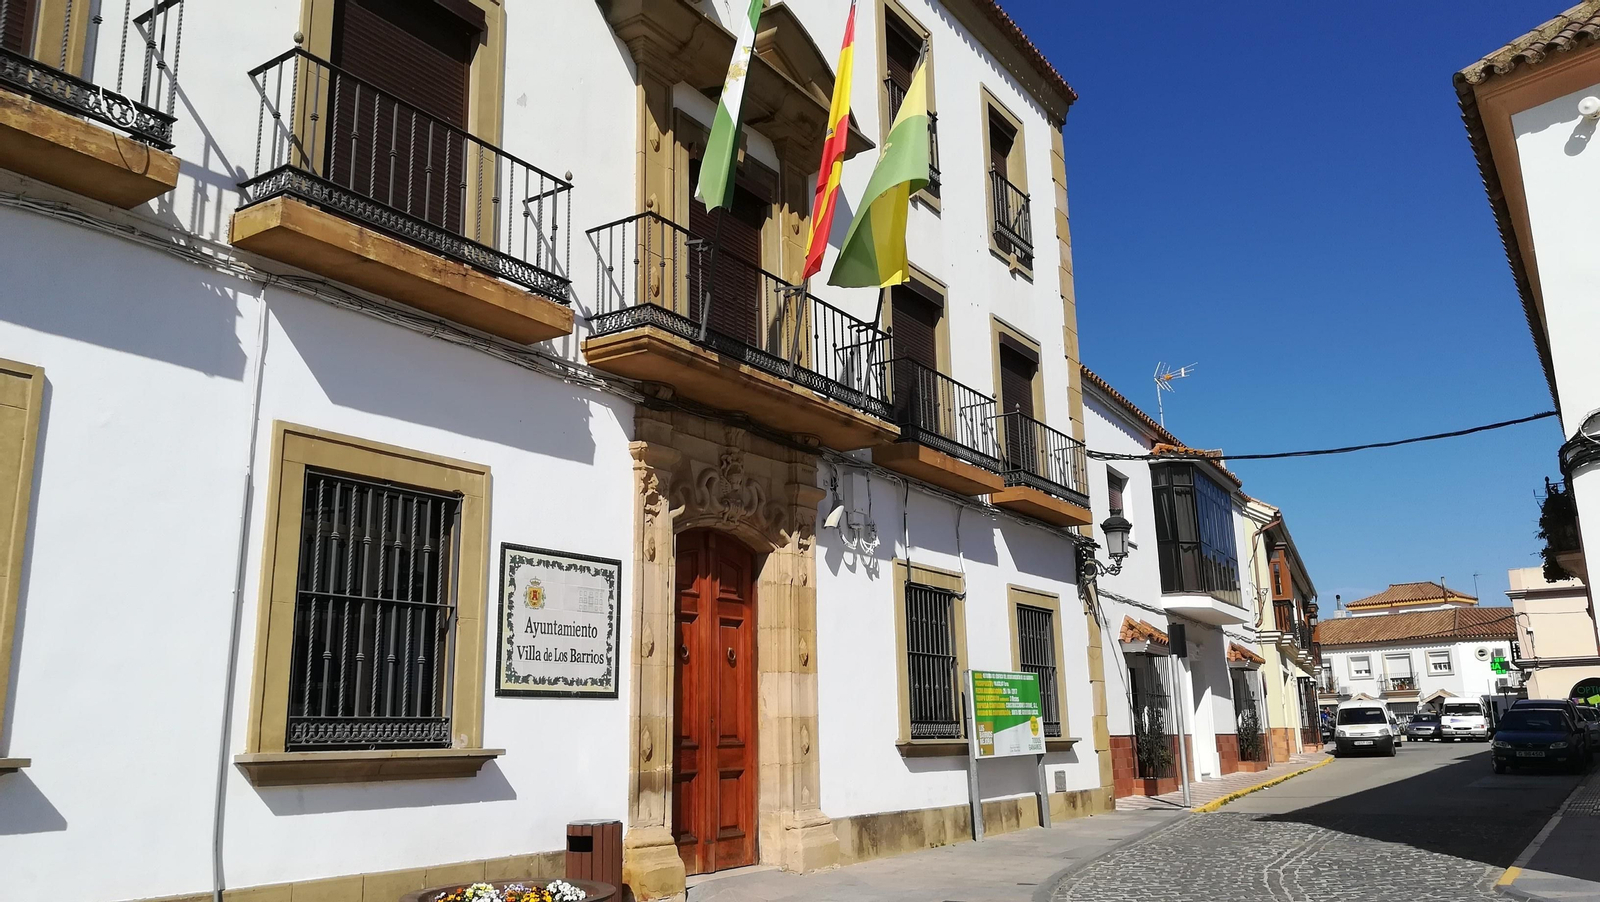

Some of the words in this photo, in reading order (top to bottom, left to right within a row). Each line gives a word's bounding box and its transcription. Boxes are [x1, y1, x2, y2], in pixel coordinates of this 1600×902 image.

[524, 616, 598, 639] Ayuntamiento
[516, 645, 541, 661] Villa
[543, 648, 552, 662] de
[554, 648, 568, 663] Los
[569, 648, 605, 665] Barrios
[1577, 685, 1600, 695] OPTI
